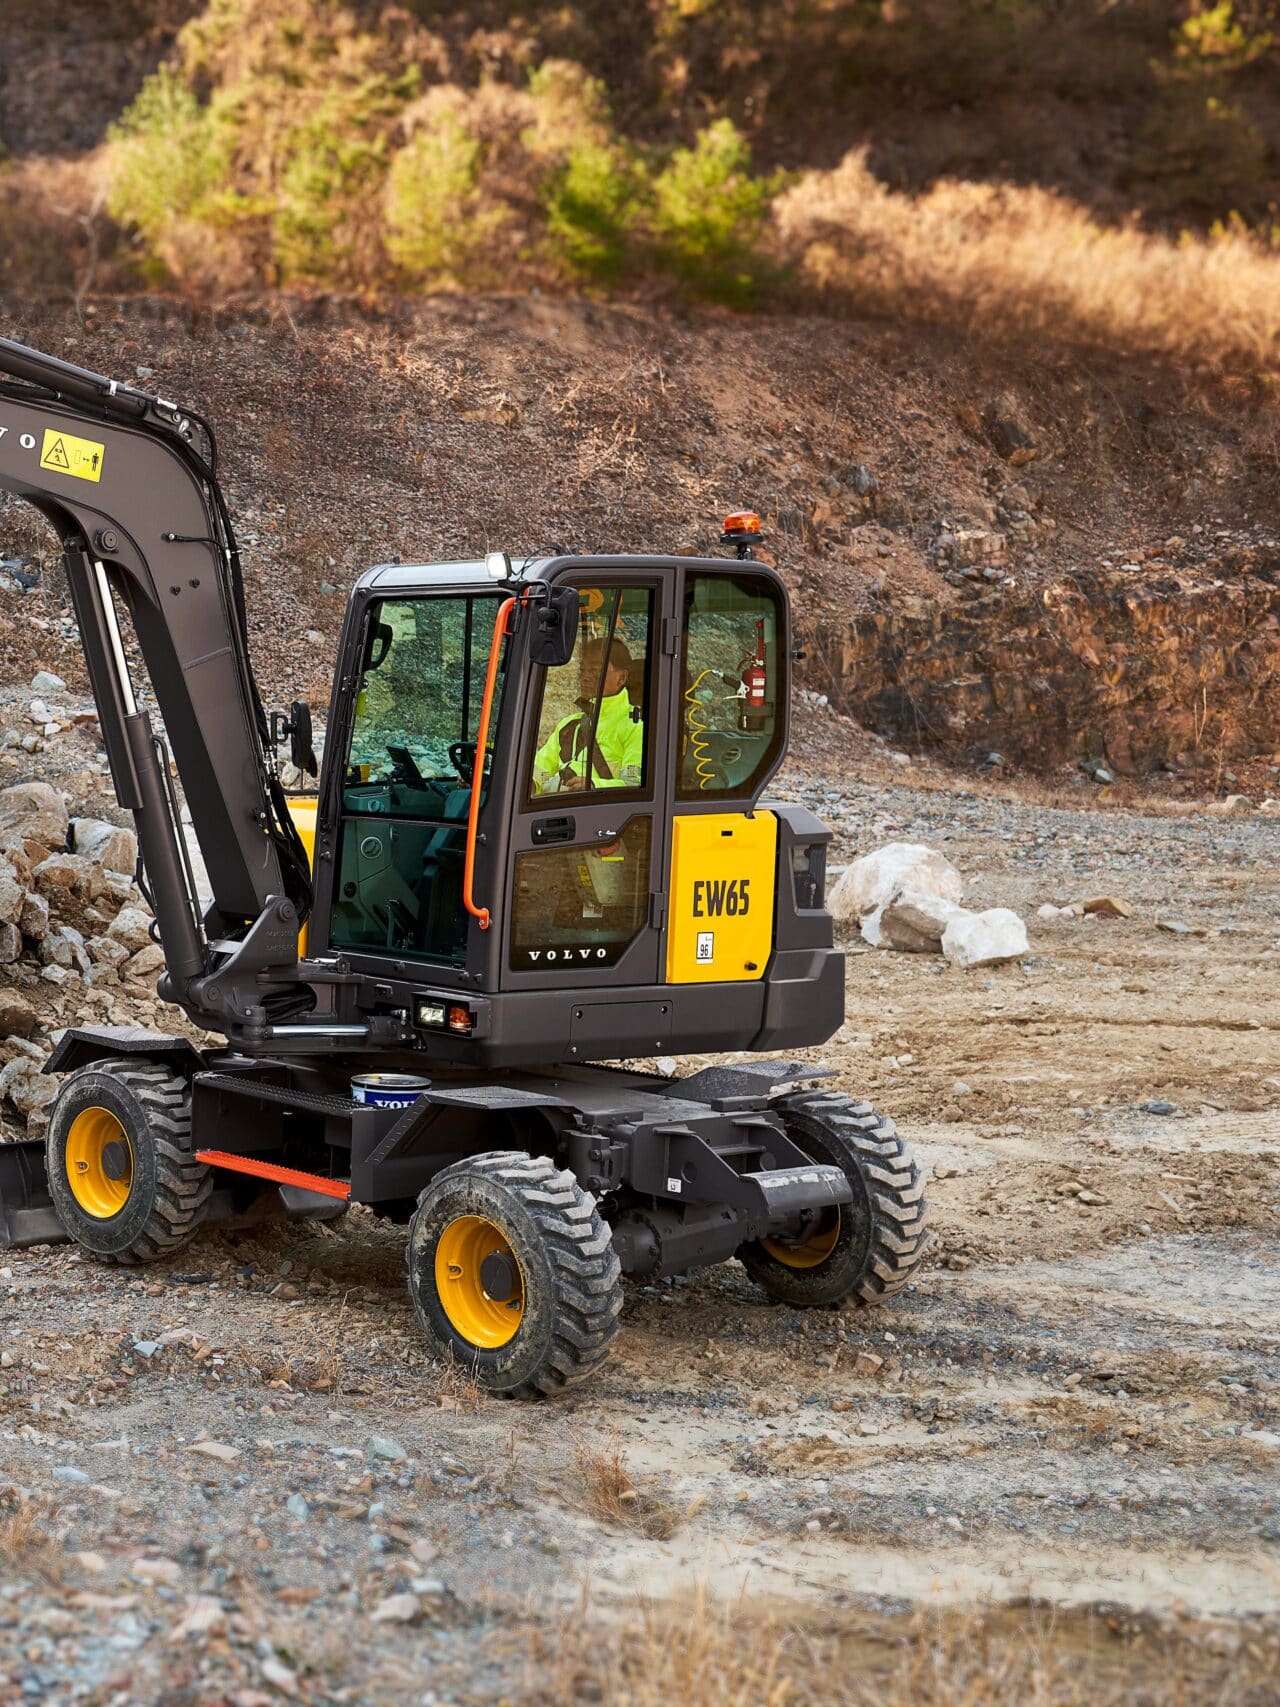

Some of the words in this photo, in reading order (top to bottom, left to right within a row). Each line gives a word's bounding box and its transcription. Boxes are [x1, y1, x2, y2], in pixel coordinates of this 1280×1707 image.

[693, 879, 750, 917] EW65
[528, 948, 607, 961] VOLVO
[700, 943, 709, 957] 96
